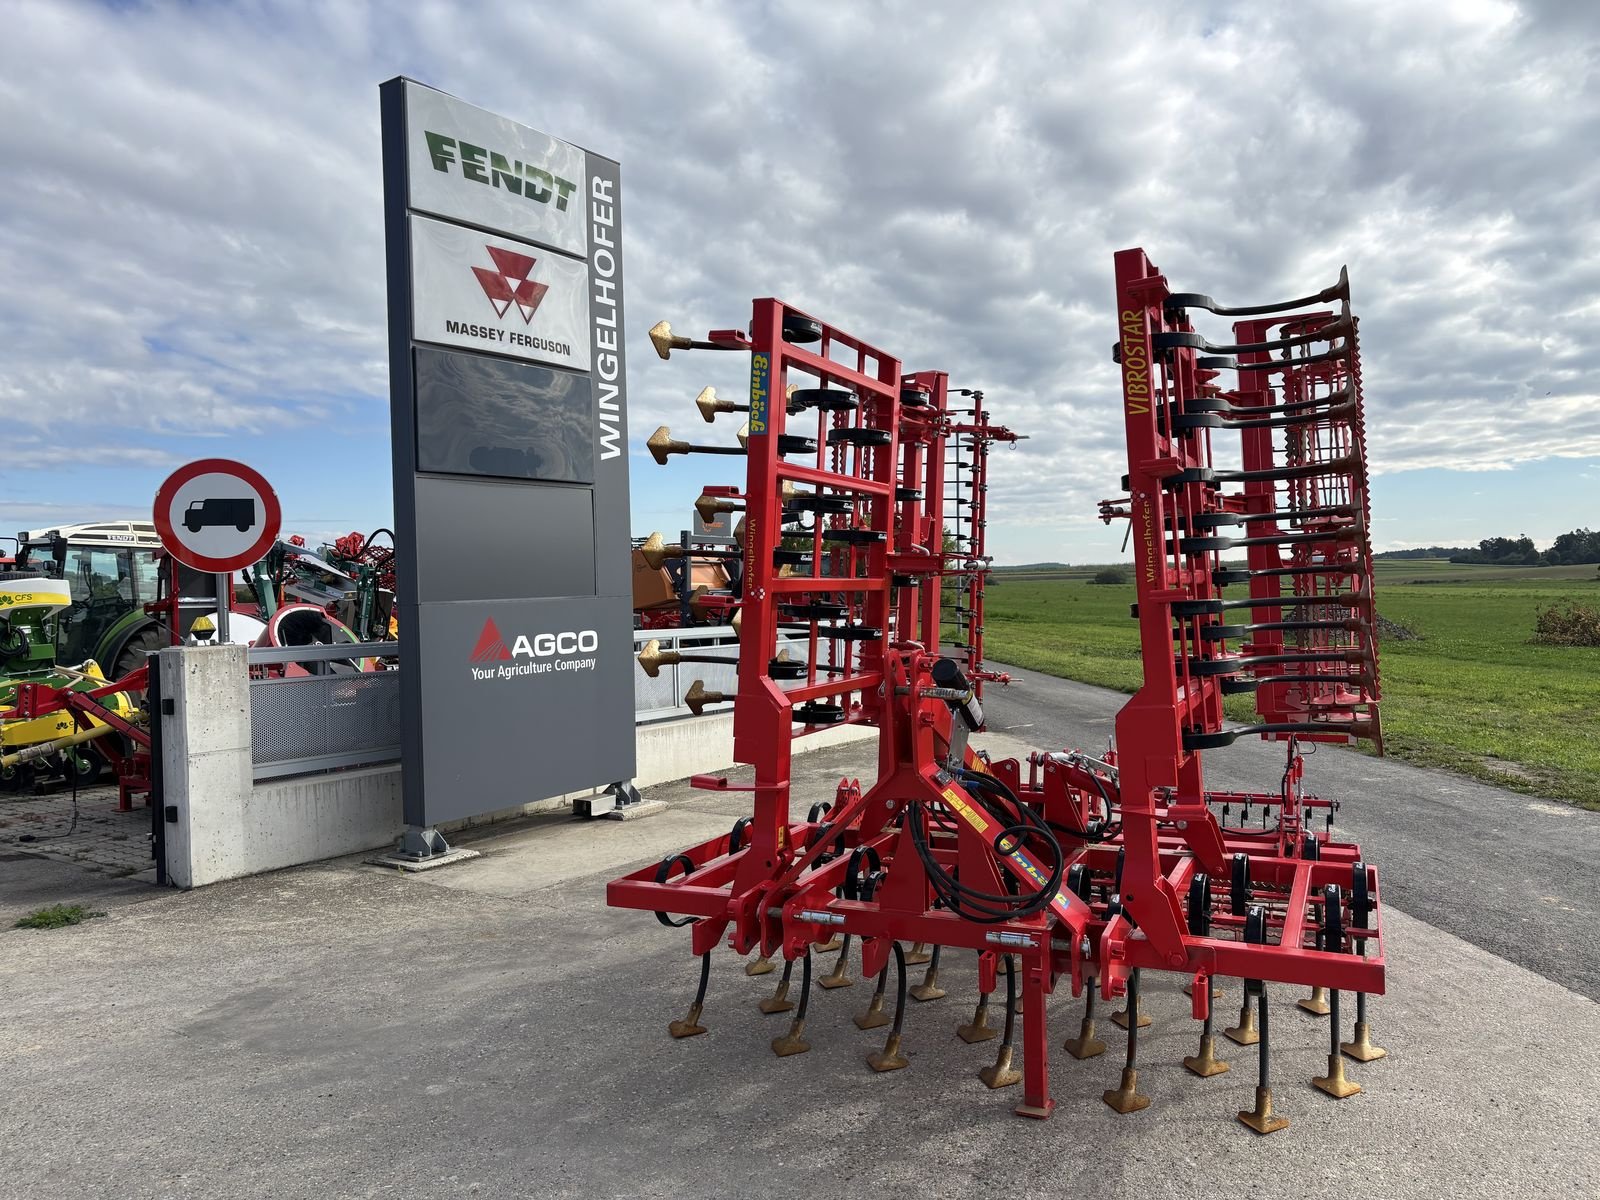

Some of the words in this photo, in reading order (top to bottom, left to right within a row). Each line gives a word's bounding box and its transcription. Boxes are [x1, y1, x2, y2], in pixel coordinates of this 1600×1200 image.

[424, 130, 577, 212] FENDT
[446, 320, 505, 342] MASSEY
[509, 332, 571, 356] FERGUSON
[592, 175, 622, 461] WINGELHOFER
[1122, 309, 1149, 416] VIBROSTAR
[750, 354, 769, 433] Einböck
[15, 594, 33, 602] CFS
[471, 667, 496, 680] Your
[497, 661, 552, 679] Agriculture
[554, 658, 596, 672] Company
[511, 630, 599, 658] AGCO
